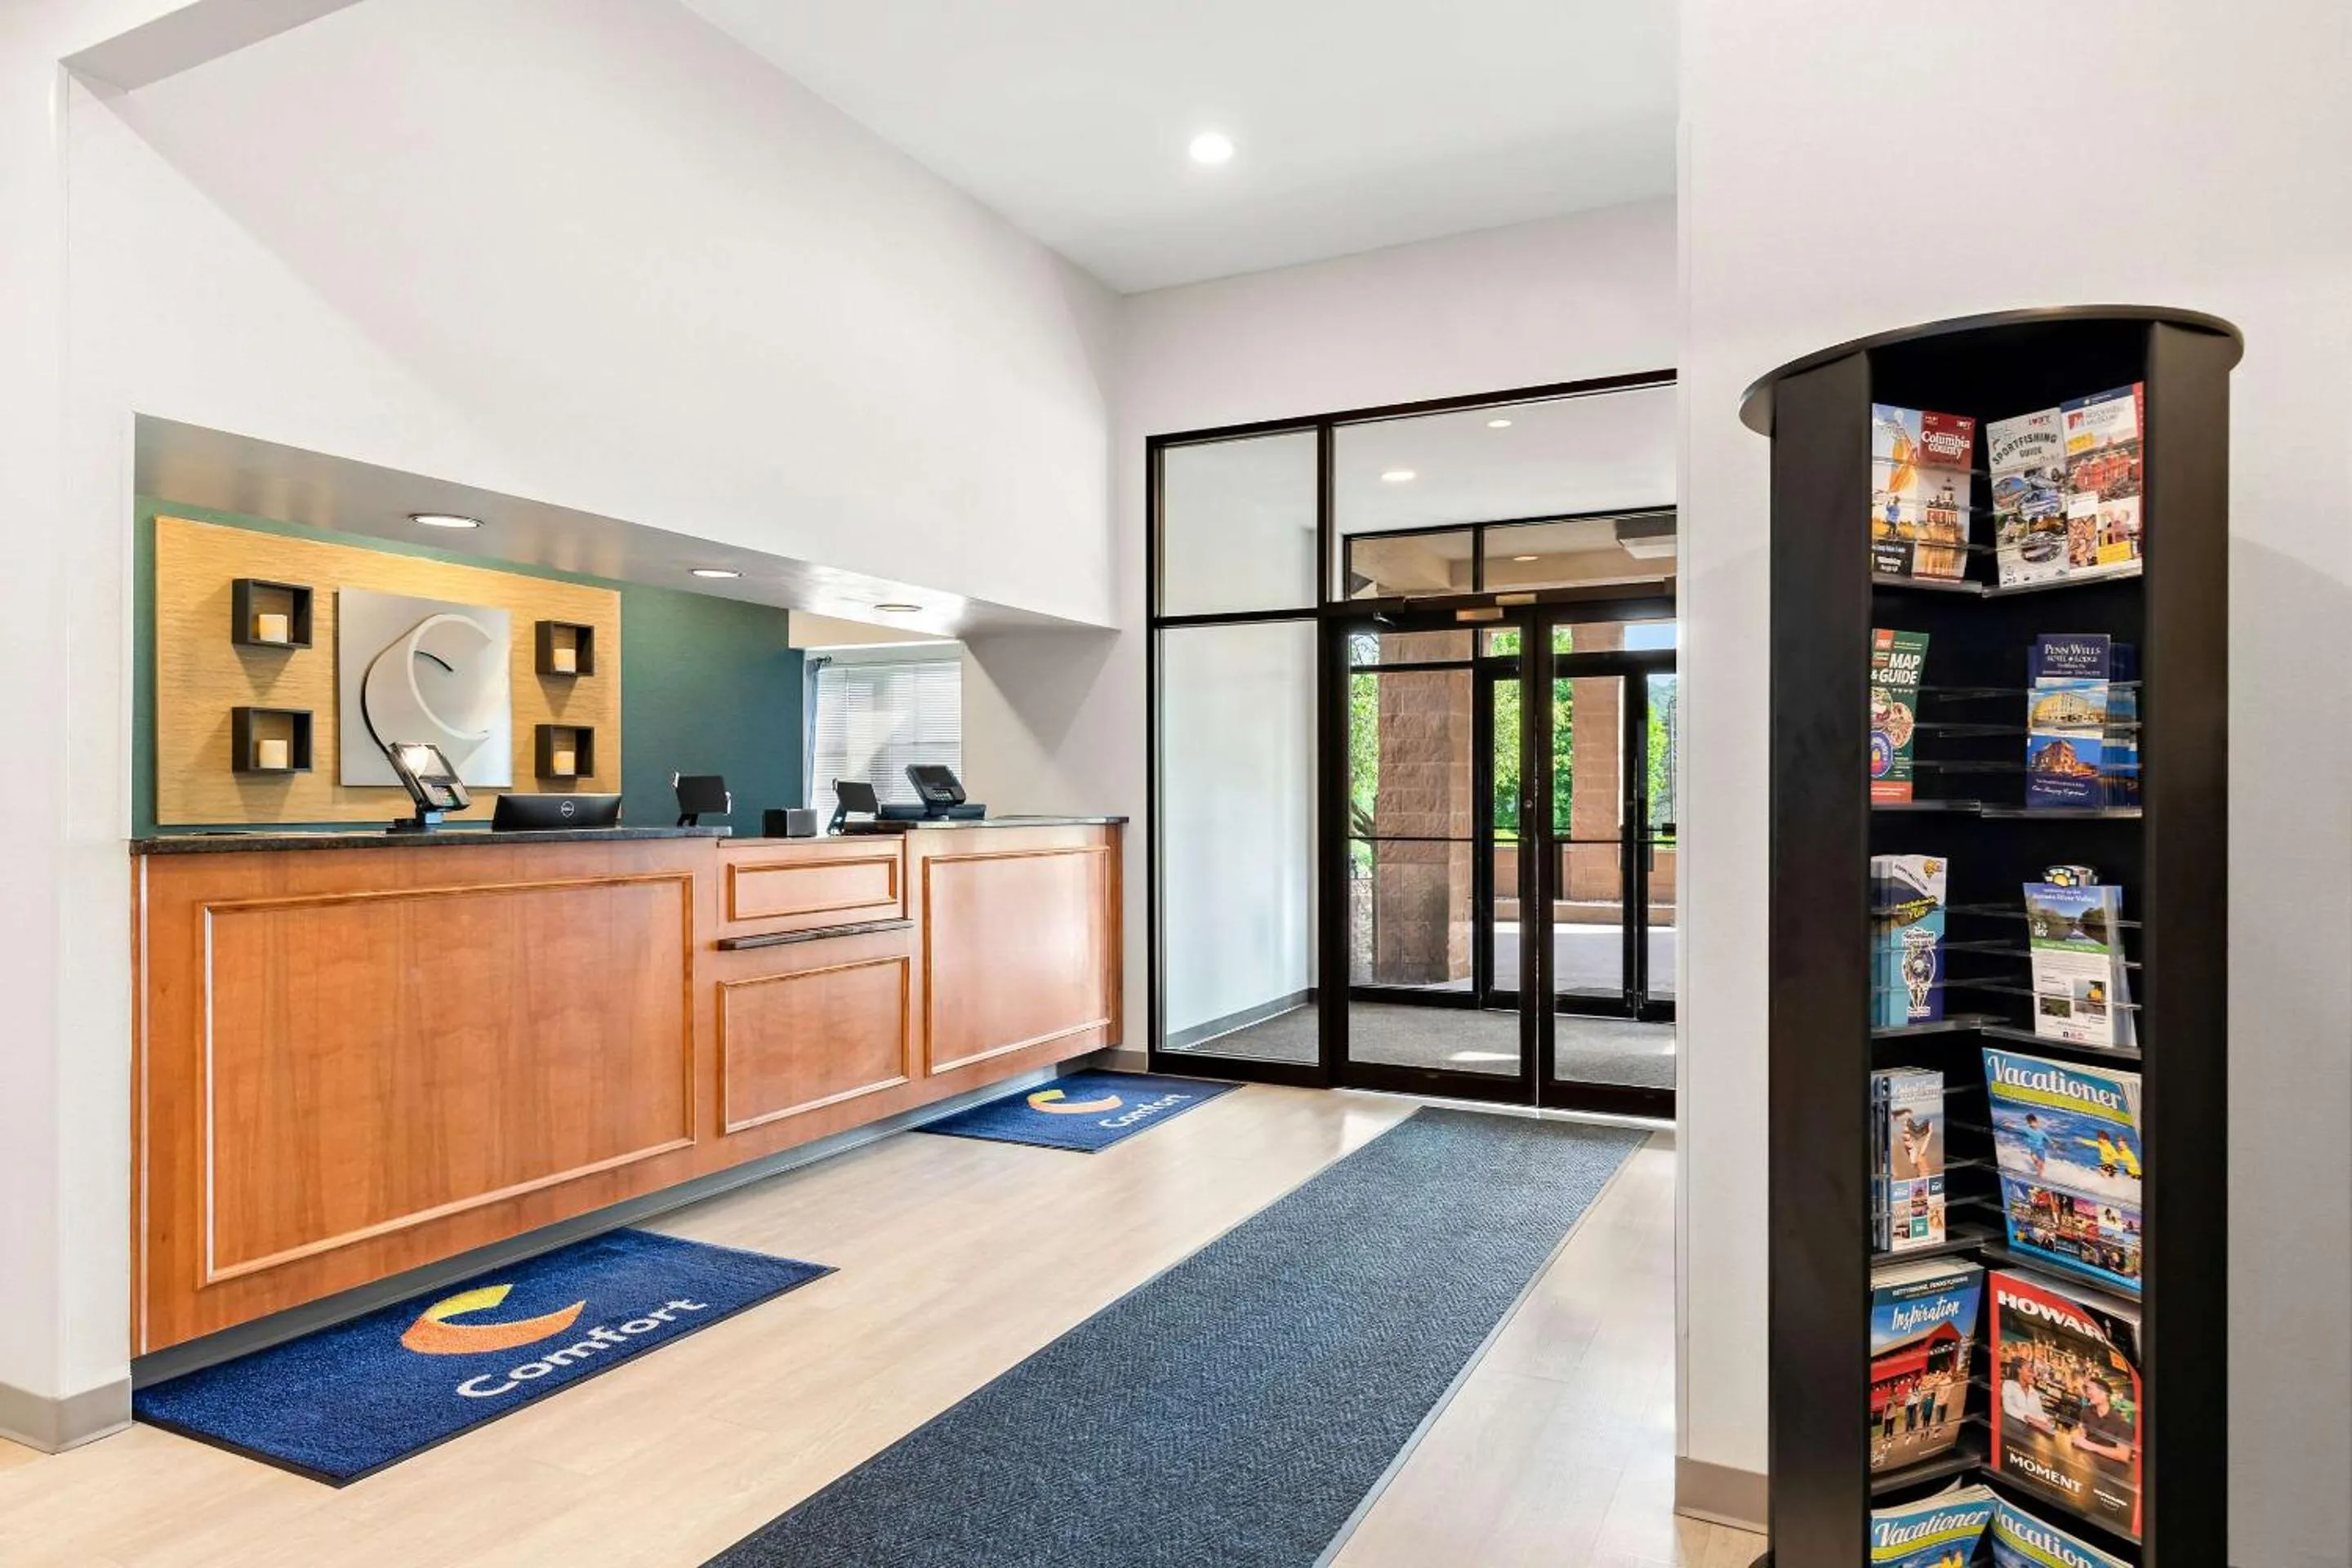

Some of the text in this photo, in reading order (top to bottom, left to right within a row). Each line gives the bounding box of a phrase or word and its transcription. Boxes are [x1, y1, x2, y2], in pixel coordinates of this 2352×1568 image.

[1922, 430, 1971, 449] Columbia
[1992, 432, 2057, 465] SPORTFISHING
[2019, 446, 2042, 457] GUIDE
[1870, 669, 1918, 684] & GUIDE
[1889, 653, 1922, 670] MAP
[1988, 1055, 2122, 1110] Vacationer
[1098, 1094, 1192, 1127] Comfort
[1892, 1297, 1960, 1333] Inspiration
[1997, 1290, 2115, 1348] HOWAR
[457, 1298, 708, 1397] Comfort
[2010, 1452, 2083, 1493] MOMENT
[1874, 1511, 1989, 1547] Vacationer
